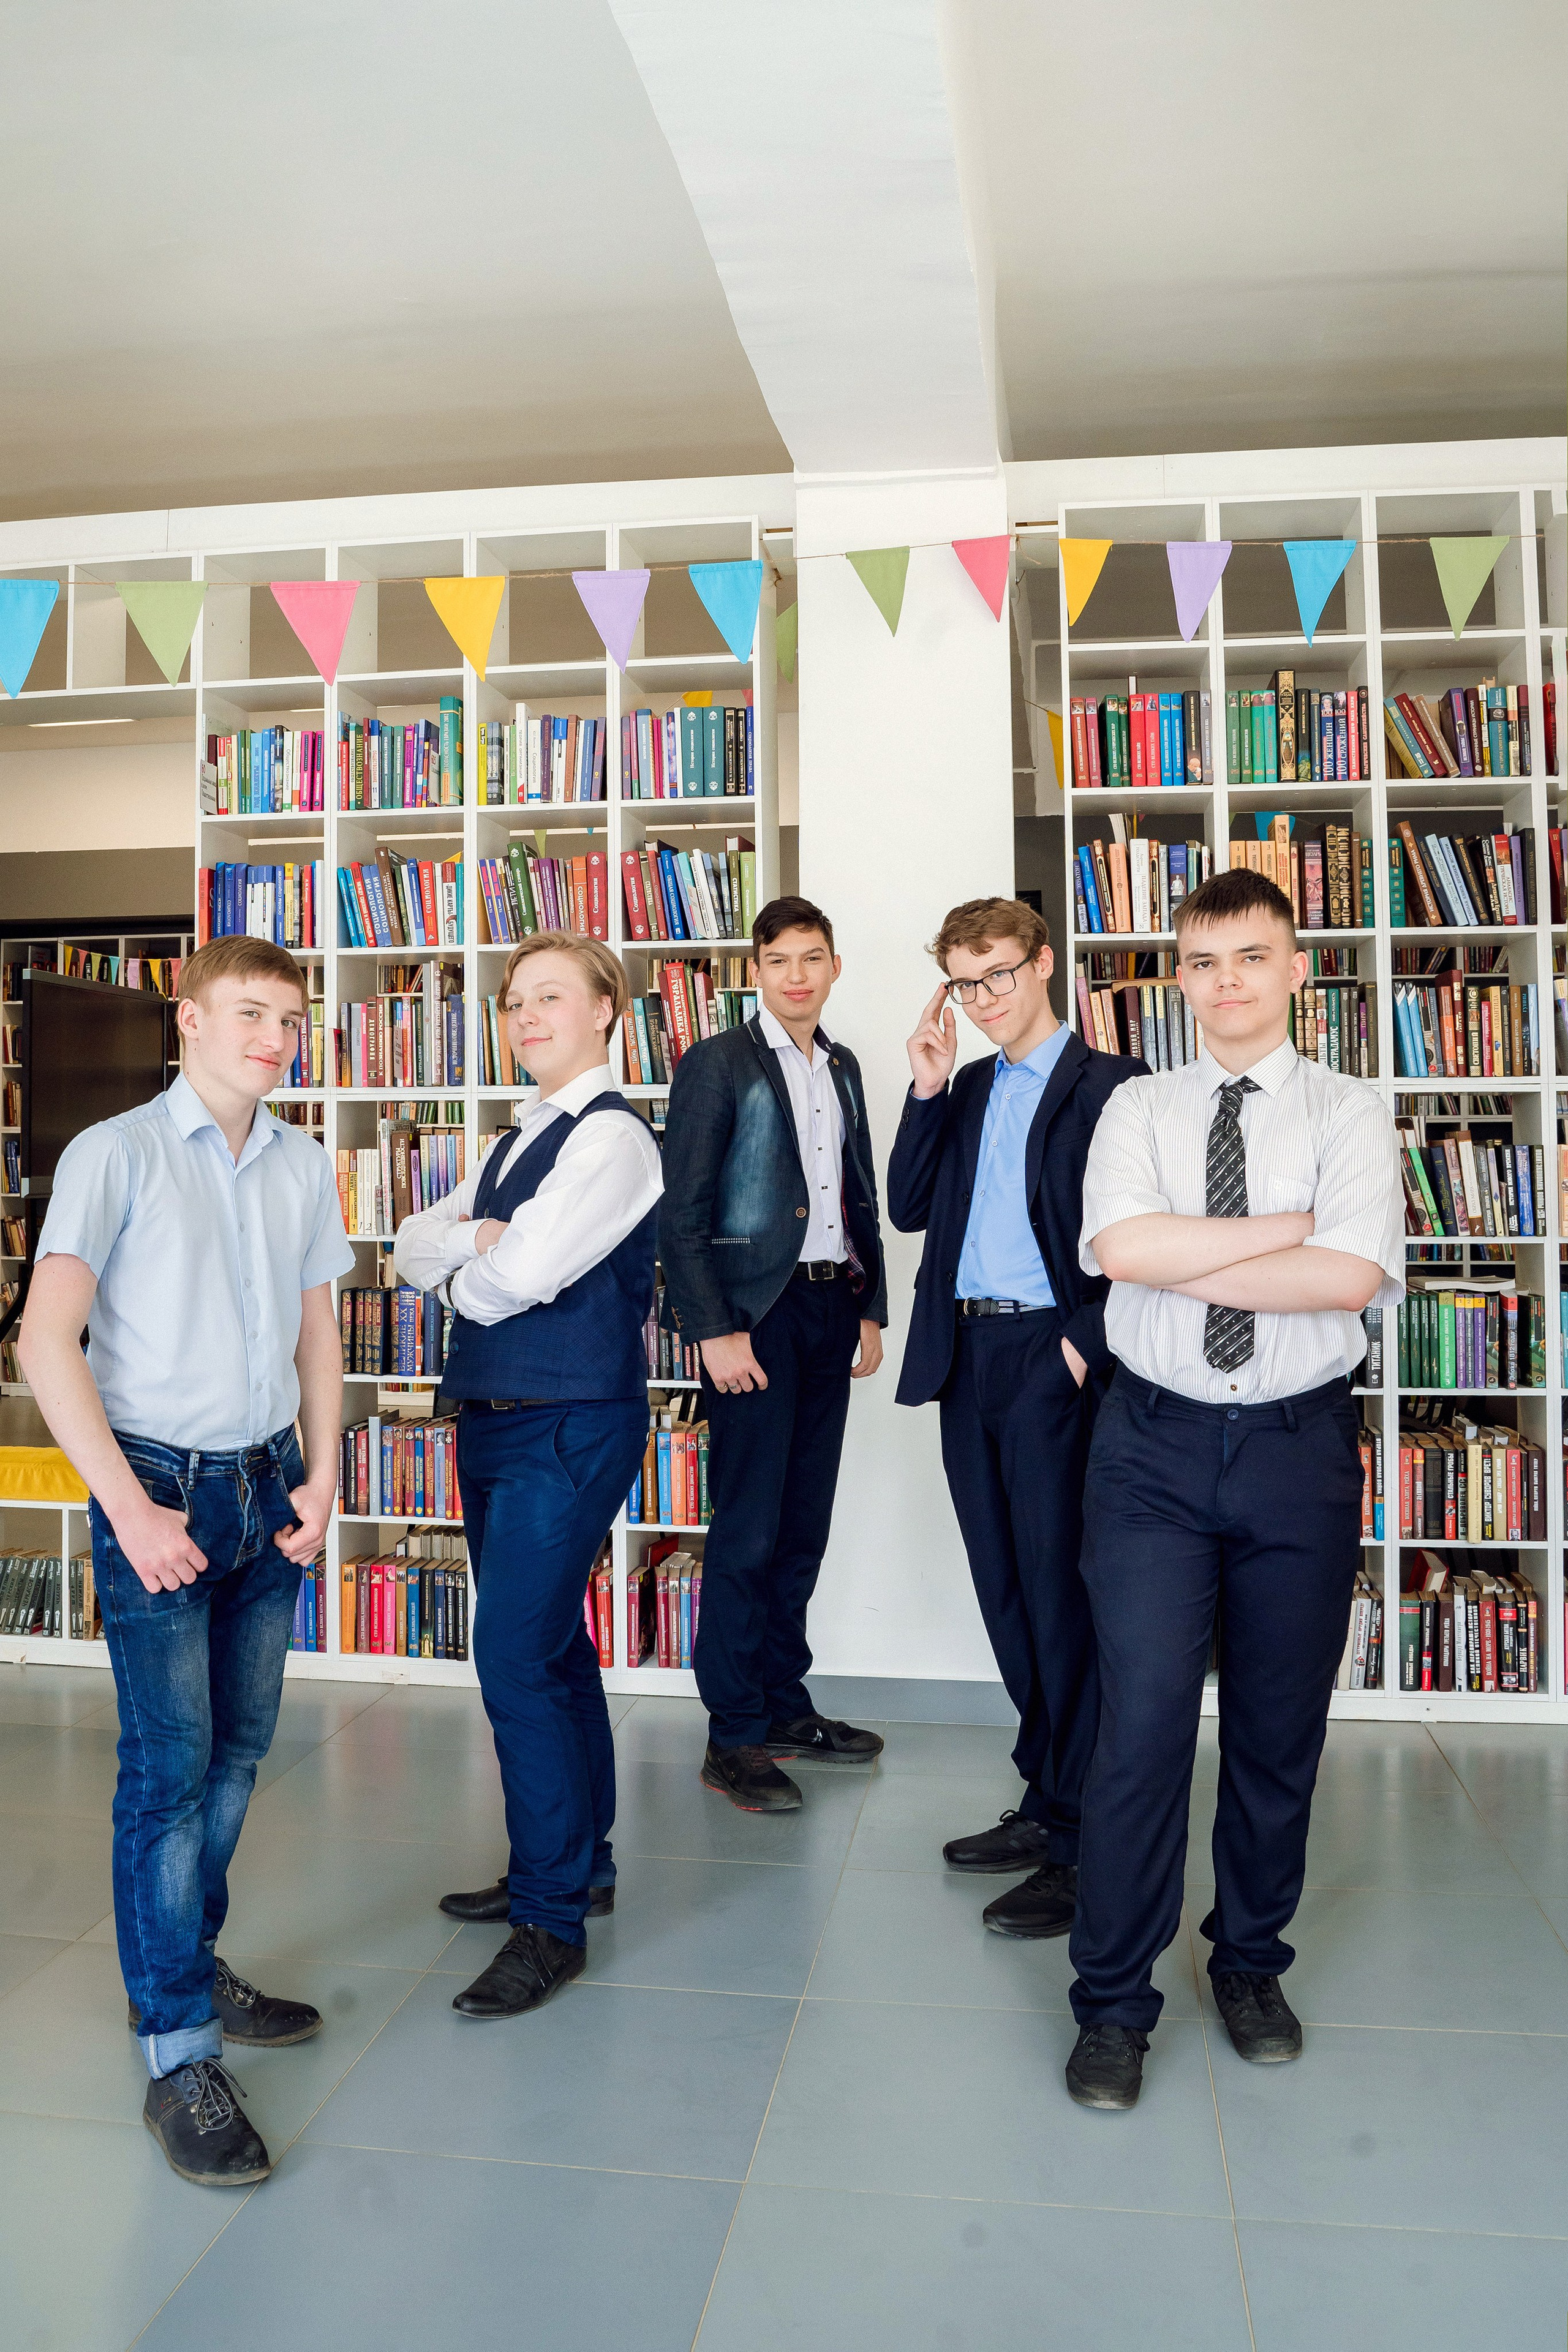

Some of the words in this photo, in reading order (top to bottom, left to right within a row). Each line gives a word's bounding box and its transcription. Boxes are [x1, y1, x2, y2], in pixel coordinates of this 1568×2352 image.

[1338, 718, 1346, 758] СРАЖЕНИЙ
[1323, 761, 1333, 777] 100
[1336, 761, 1346, 775] 100
[385, 872, 394, 908] ТЕОРЕТИЧЕСКИЕ
[423, 869, 432, 913] СОЦИОЛОГИЯ
[1415, 864, 1427, 888] ДРЕВНЕГО
[364, 878, 382, 934] СОЦИОЛОГИЯ
[373, 876, 389, 933] СОЦИОЛОГИЯ
[576, 886, 585, 931] СОЦИОЛОГИЯ
[630, 877, 639, 912] Социология
[669, 892, 679, 925] СОЦИОЛОГИЯ
[1423, 888, 1434, 912] ИСТОРИЯ
[627, 1017, 636, 1046] ТЫСЯЧЕЛЕТИЙ
[1130, 1034, 1139, 1058] РЕВНИЙ
[1330, 1027, 1339, 1072] НОСТРАДАМУС
[1371, 1341, 1381, 1370] ТИТАНИК
